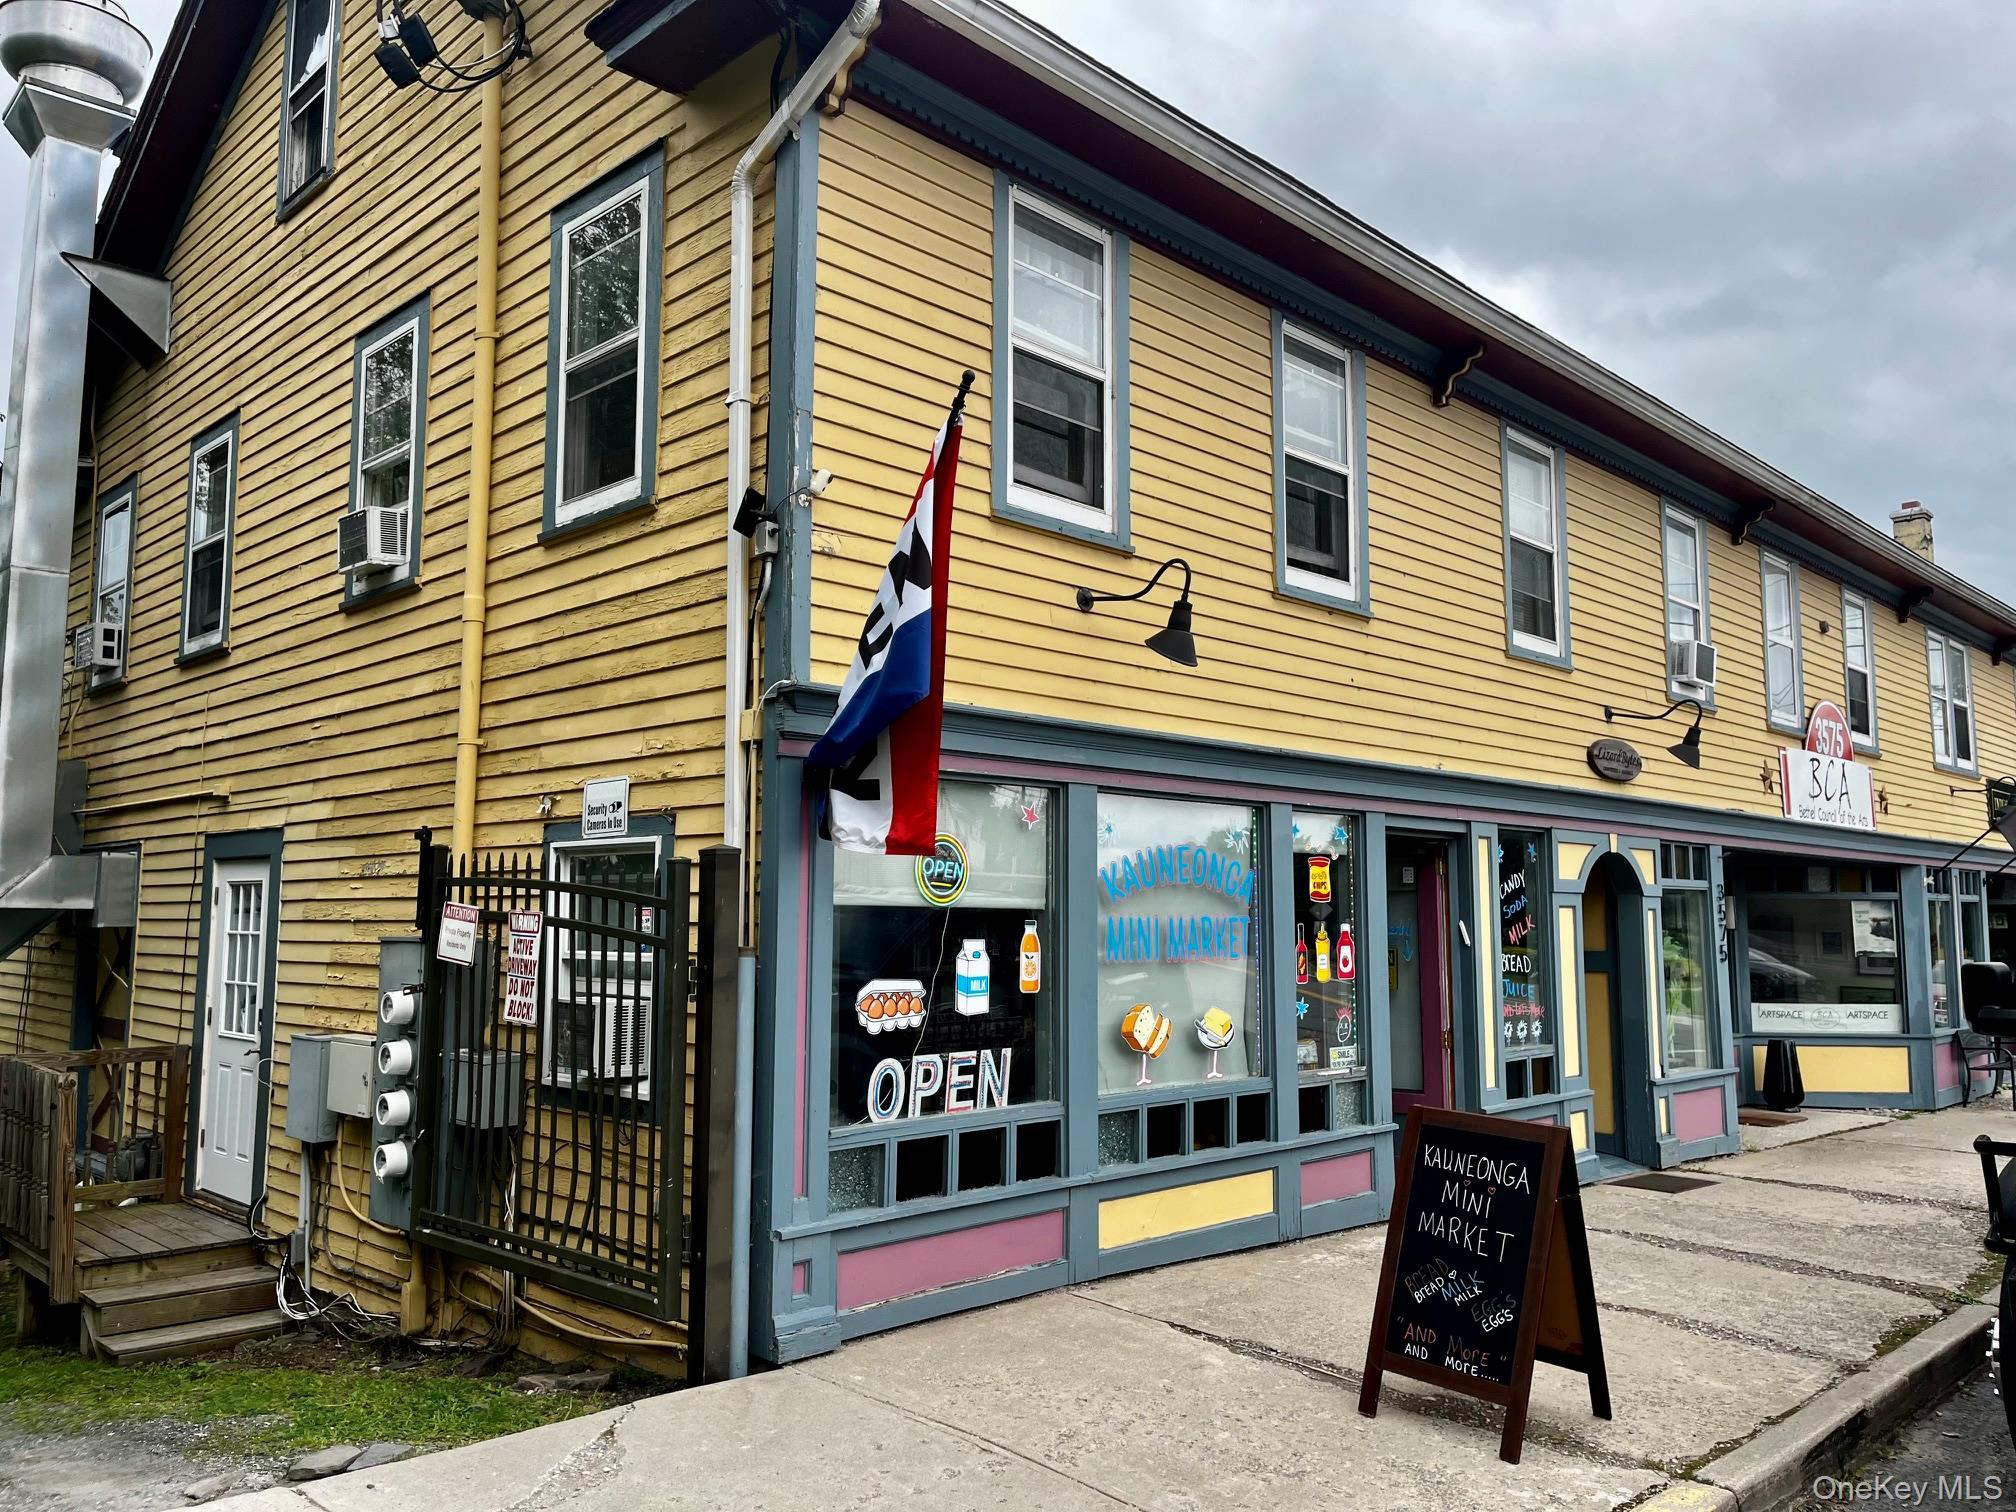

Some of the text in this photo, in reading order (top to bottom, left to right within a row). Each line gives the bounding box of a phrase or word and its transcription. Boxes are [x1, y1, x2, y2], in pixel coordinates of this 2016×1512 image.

[1815, 717, 1845, 759] 3575
[1809, 757, 1852, 815] BCA
[587, 803, 608, 817] Security
[587, 818, 607, 831] Cameras
[613, 816, 623, 828] Use
[922, 857, 964, 881] OPEN
[1100, 844, 1255, 906] KAUNEONGA
[1499, 868, 1526, 900] CANDY
[446, 905, 475, 921] ATTENTION
[1503, 895, 1529, 919] SODA
[510, 912, 539, 932] WARNING
[1508, 914, 1536, 946] MILK
[512, 938, 534, 956] ACTIVE
[1106, 914, 1250, 963] MINI MARKET
[507, 956, 538, 978] DRIVEWAY
[508, 977, 535, 999] DO NOT
[970, 980, 986, 993] MILK
[507, 999, 534, 1021] BLOCK!
[1759, 1009, 1803, 1019] ARTSPACE
[1846, 1009, 1889, 1020] ARTSPACE
[867, 1047, 1012, 1123] OPEN
[1424, 1143, 1531, 1195] KAUNEONGA
[1418, 1211, 1515, 1262] MARKET
[1454, 1285, 1483, 1307] MILK
[1481, 1308, 1514, 1333] EGG'S
[1404, 1342, 1429, 1360] AND
